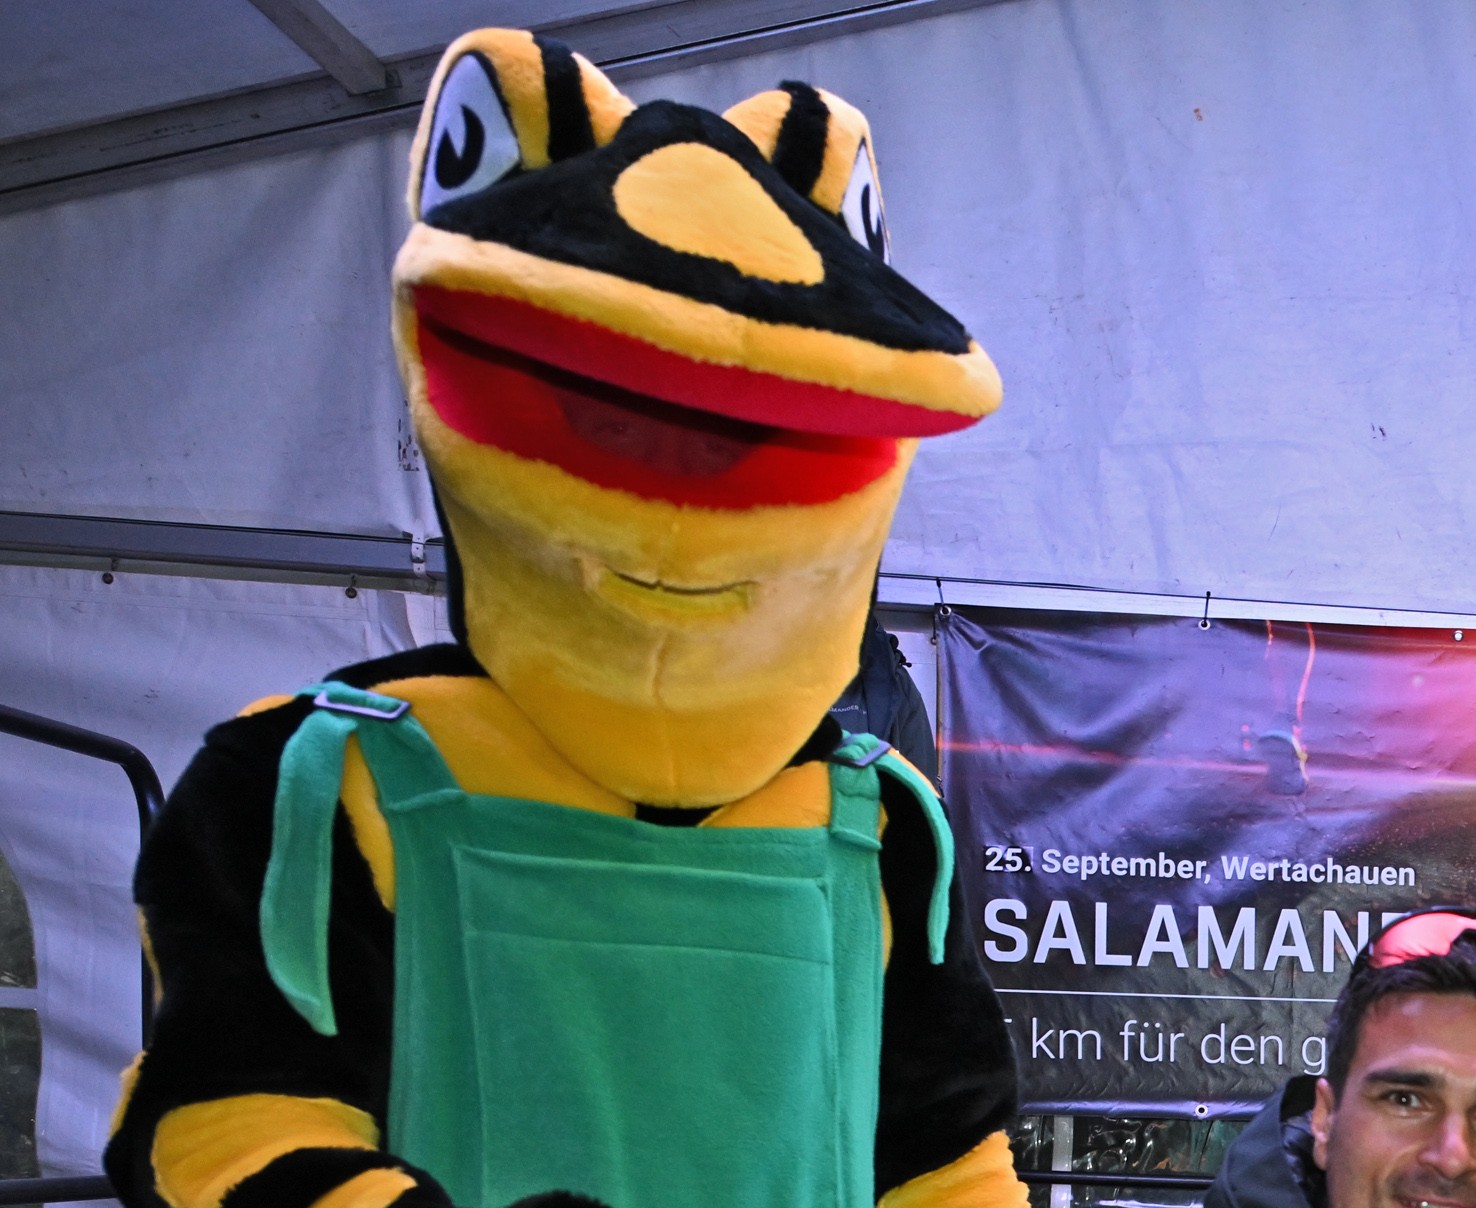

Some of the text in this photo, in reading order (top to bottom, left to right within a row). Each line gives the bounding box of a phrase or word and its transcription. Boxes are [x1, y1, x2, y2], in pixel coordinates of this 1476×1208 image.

[984, 846, 1416, 887] 25. September, Wertachauen
[1031, 1017, 1101, 1061] km
[1119, 1019, 1185, 1062] für
[1200, 1022, 1285, 1066] den
